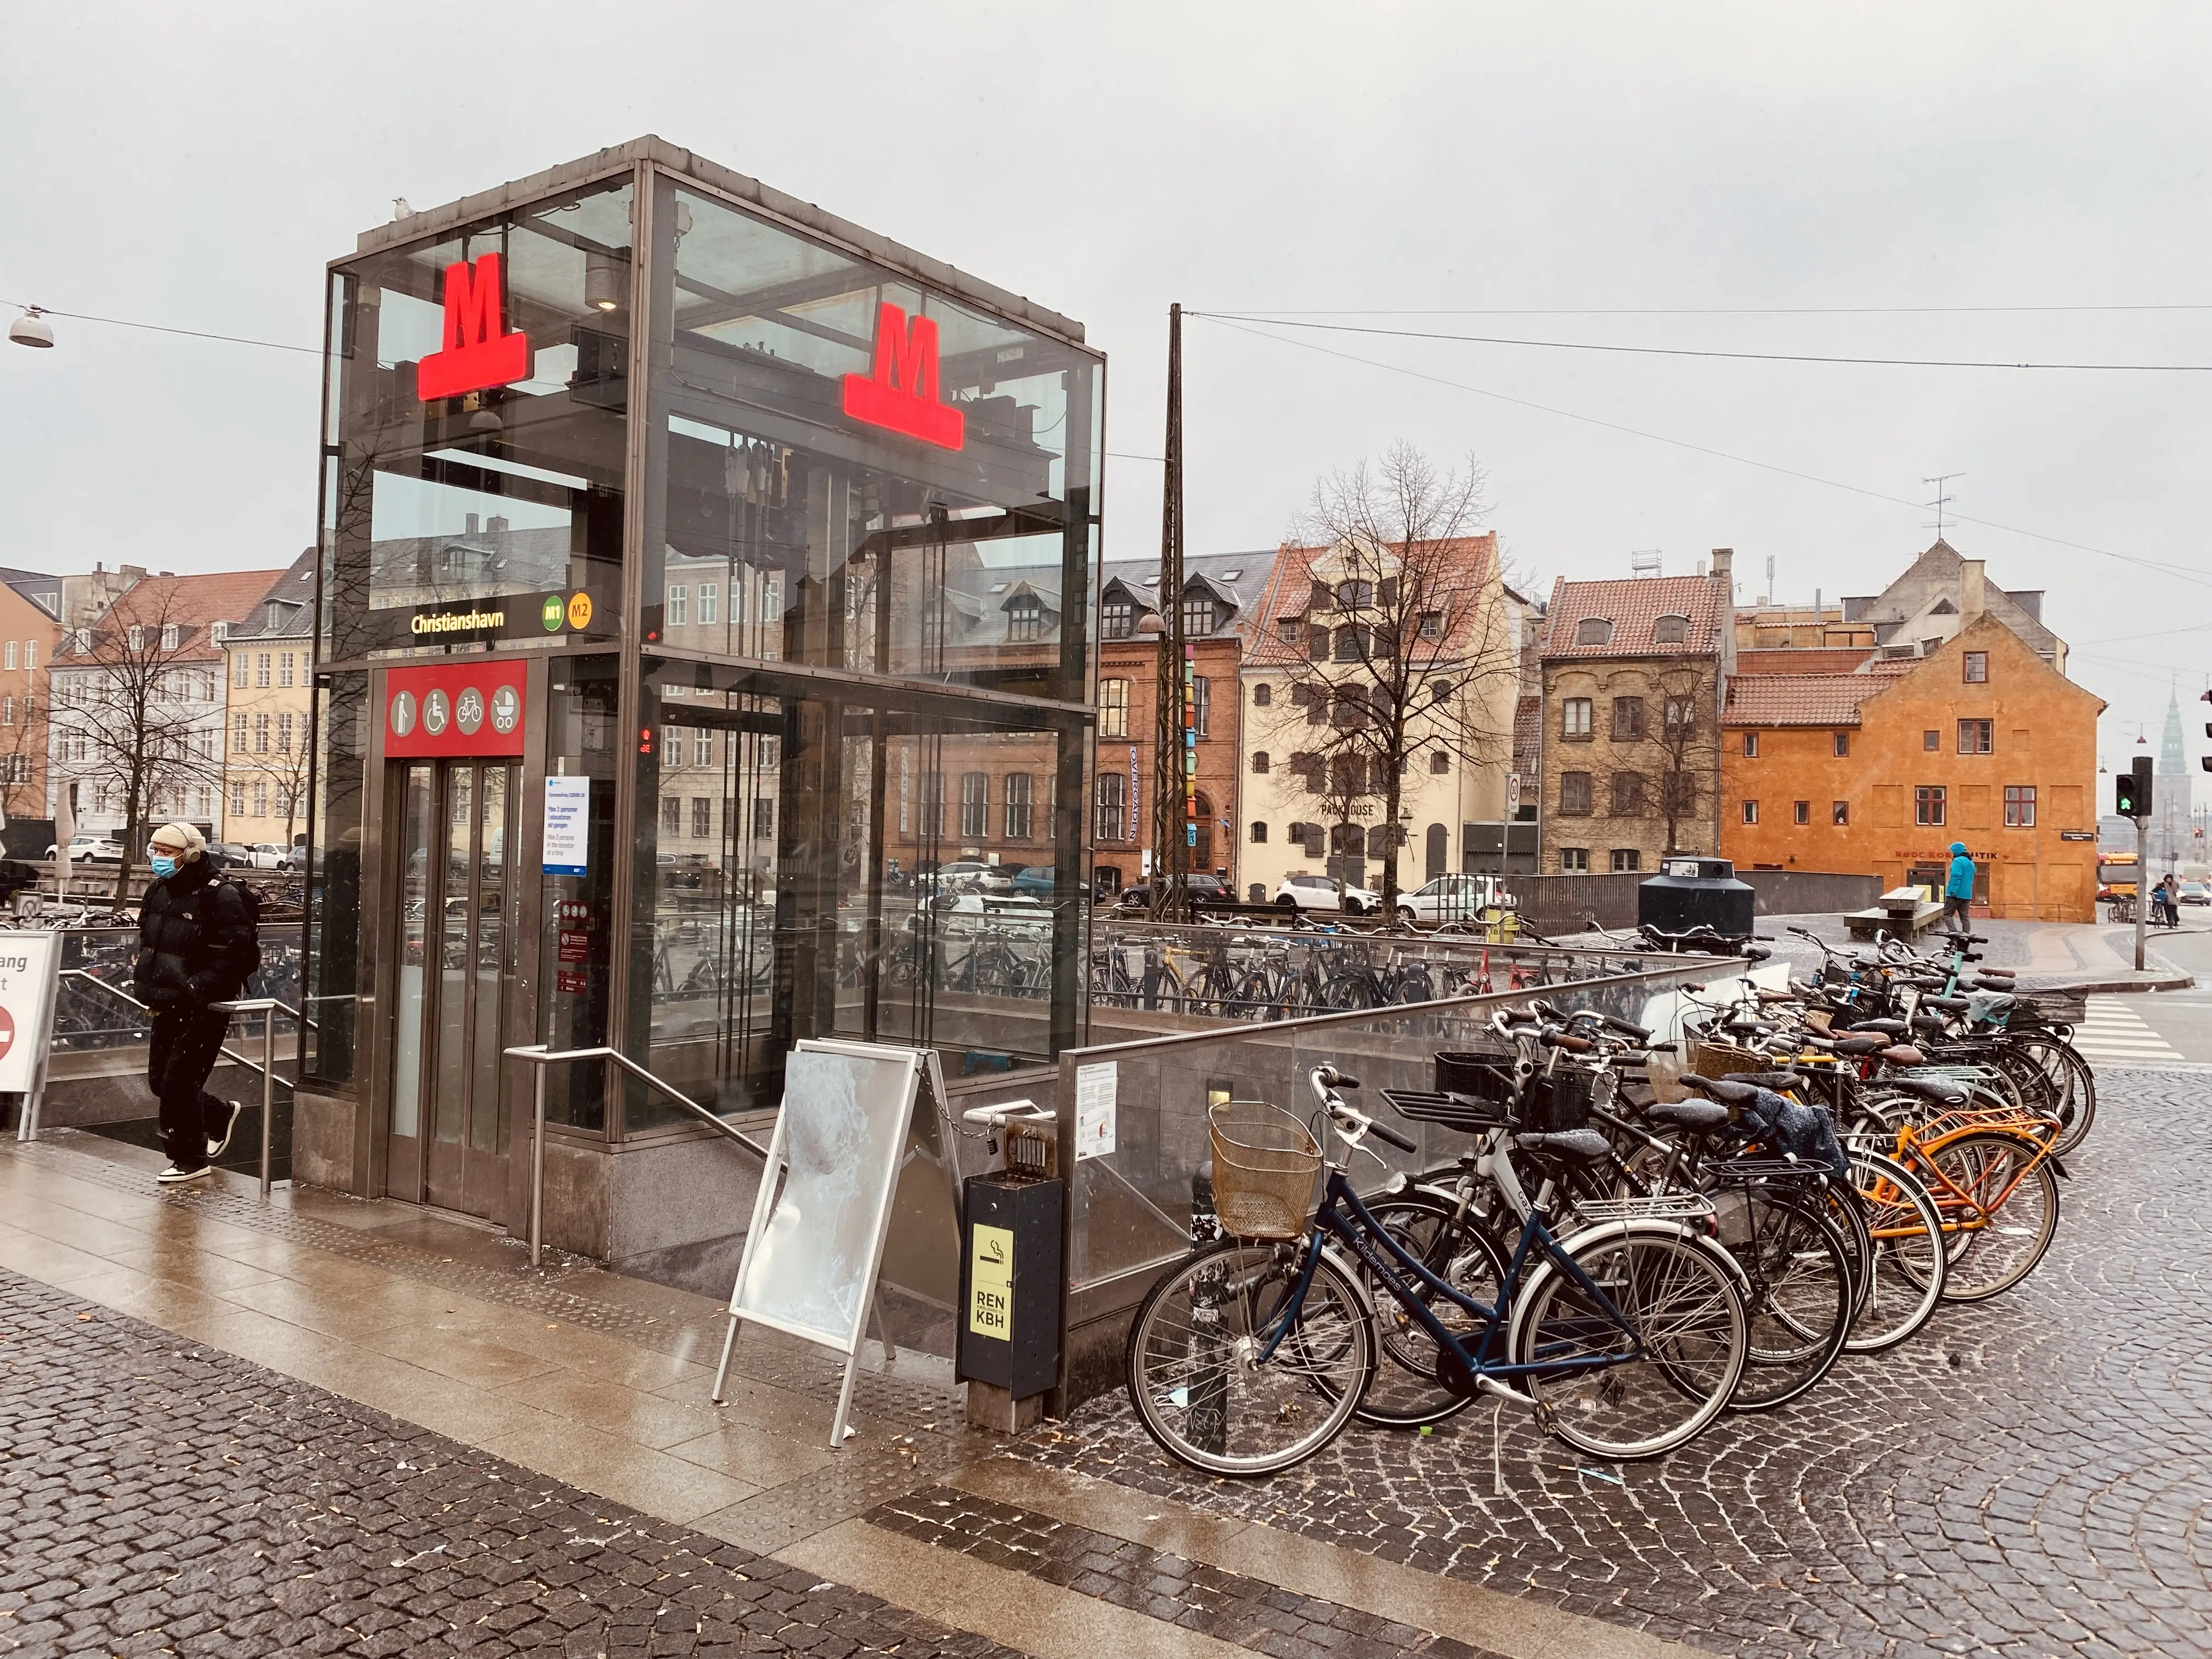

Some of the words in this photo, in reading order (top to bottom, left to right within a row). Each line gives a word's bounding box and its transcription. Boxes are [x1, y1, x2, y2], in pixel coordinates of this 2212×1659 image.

[545, 605, 561, 620] M1
[572, 603, 588, 617] M2
[411, 609, 504, 634] Christianshavn
[1129, 750, 1138, 839] OVERGADEN
[1322, 805, 1374, 815] PACKOUSE
[1658, 1176, 1669, 1196] azelle
[1353, 1237, 1401, 1291] Kildemoes
[977, 1291, 1005, 1310] REN
[977, 1310, 1004, 1329] KBH
